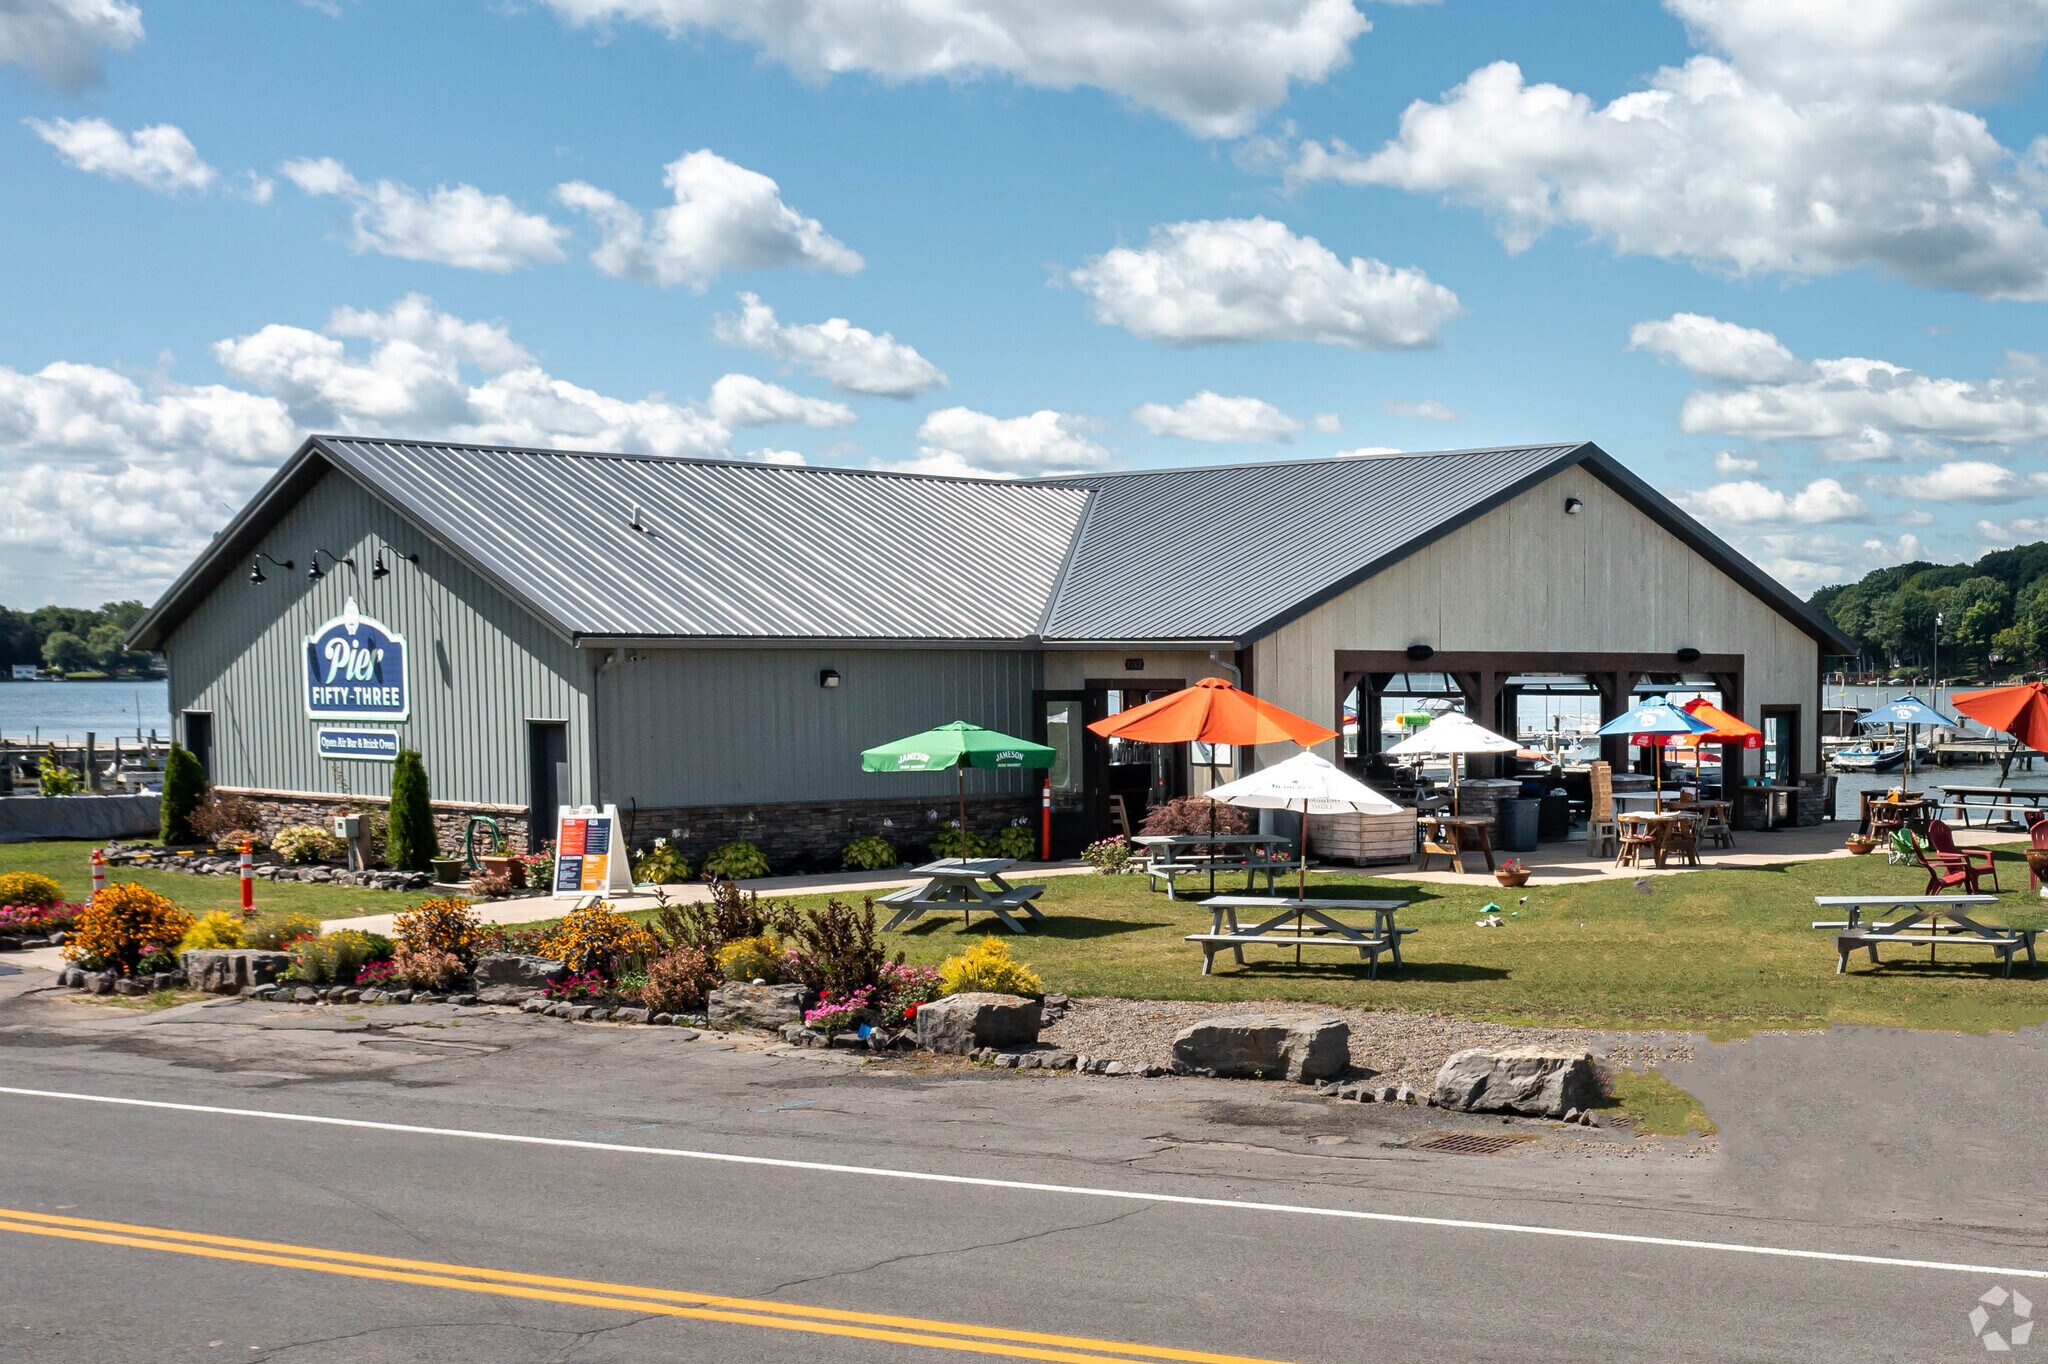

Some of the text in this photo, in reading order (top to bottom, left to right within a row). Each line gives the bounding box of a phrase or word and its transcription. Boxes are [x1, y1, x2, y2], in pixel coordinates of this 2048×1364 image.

[325, 637, 384, 684] Pier
[312, 686, 400, 706] FIFTY-THREE
[995, 750, 1024, 761] JAMESON
